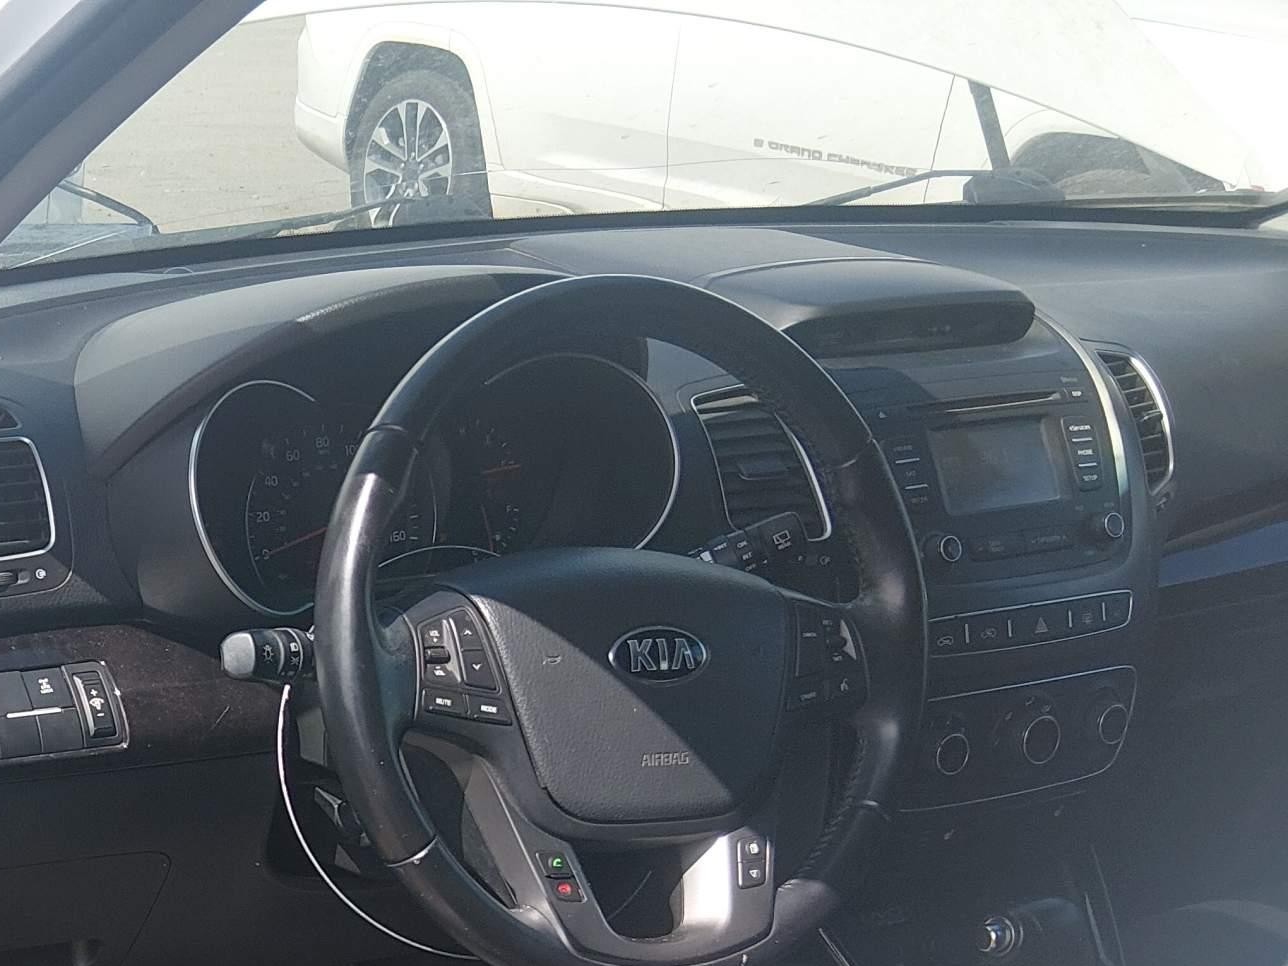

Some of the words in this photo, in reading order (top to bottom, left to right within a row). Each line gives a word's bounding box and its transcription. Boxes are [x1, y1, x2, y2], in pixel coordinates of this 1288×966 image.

[767, 140, 823, 161] GRAND
[256, 511, 270, 523] 20
[626, 637, 696, 673] KIA
[641, 751, 689, 768] AIRBAG
